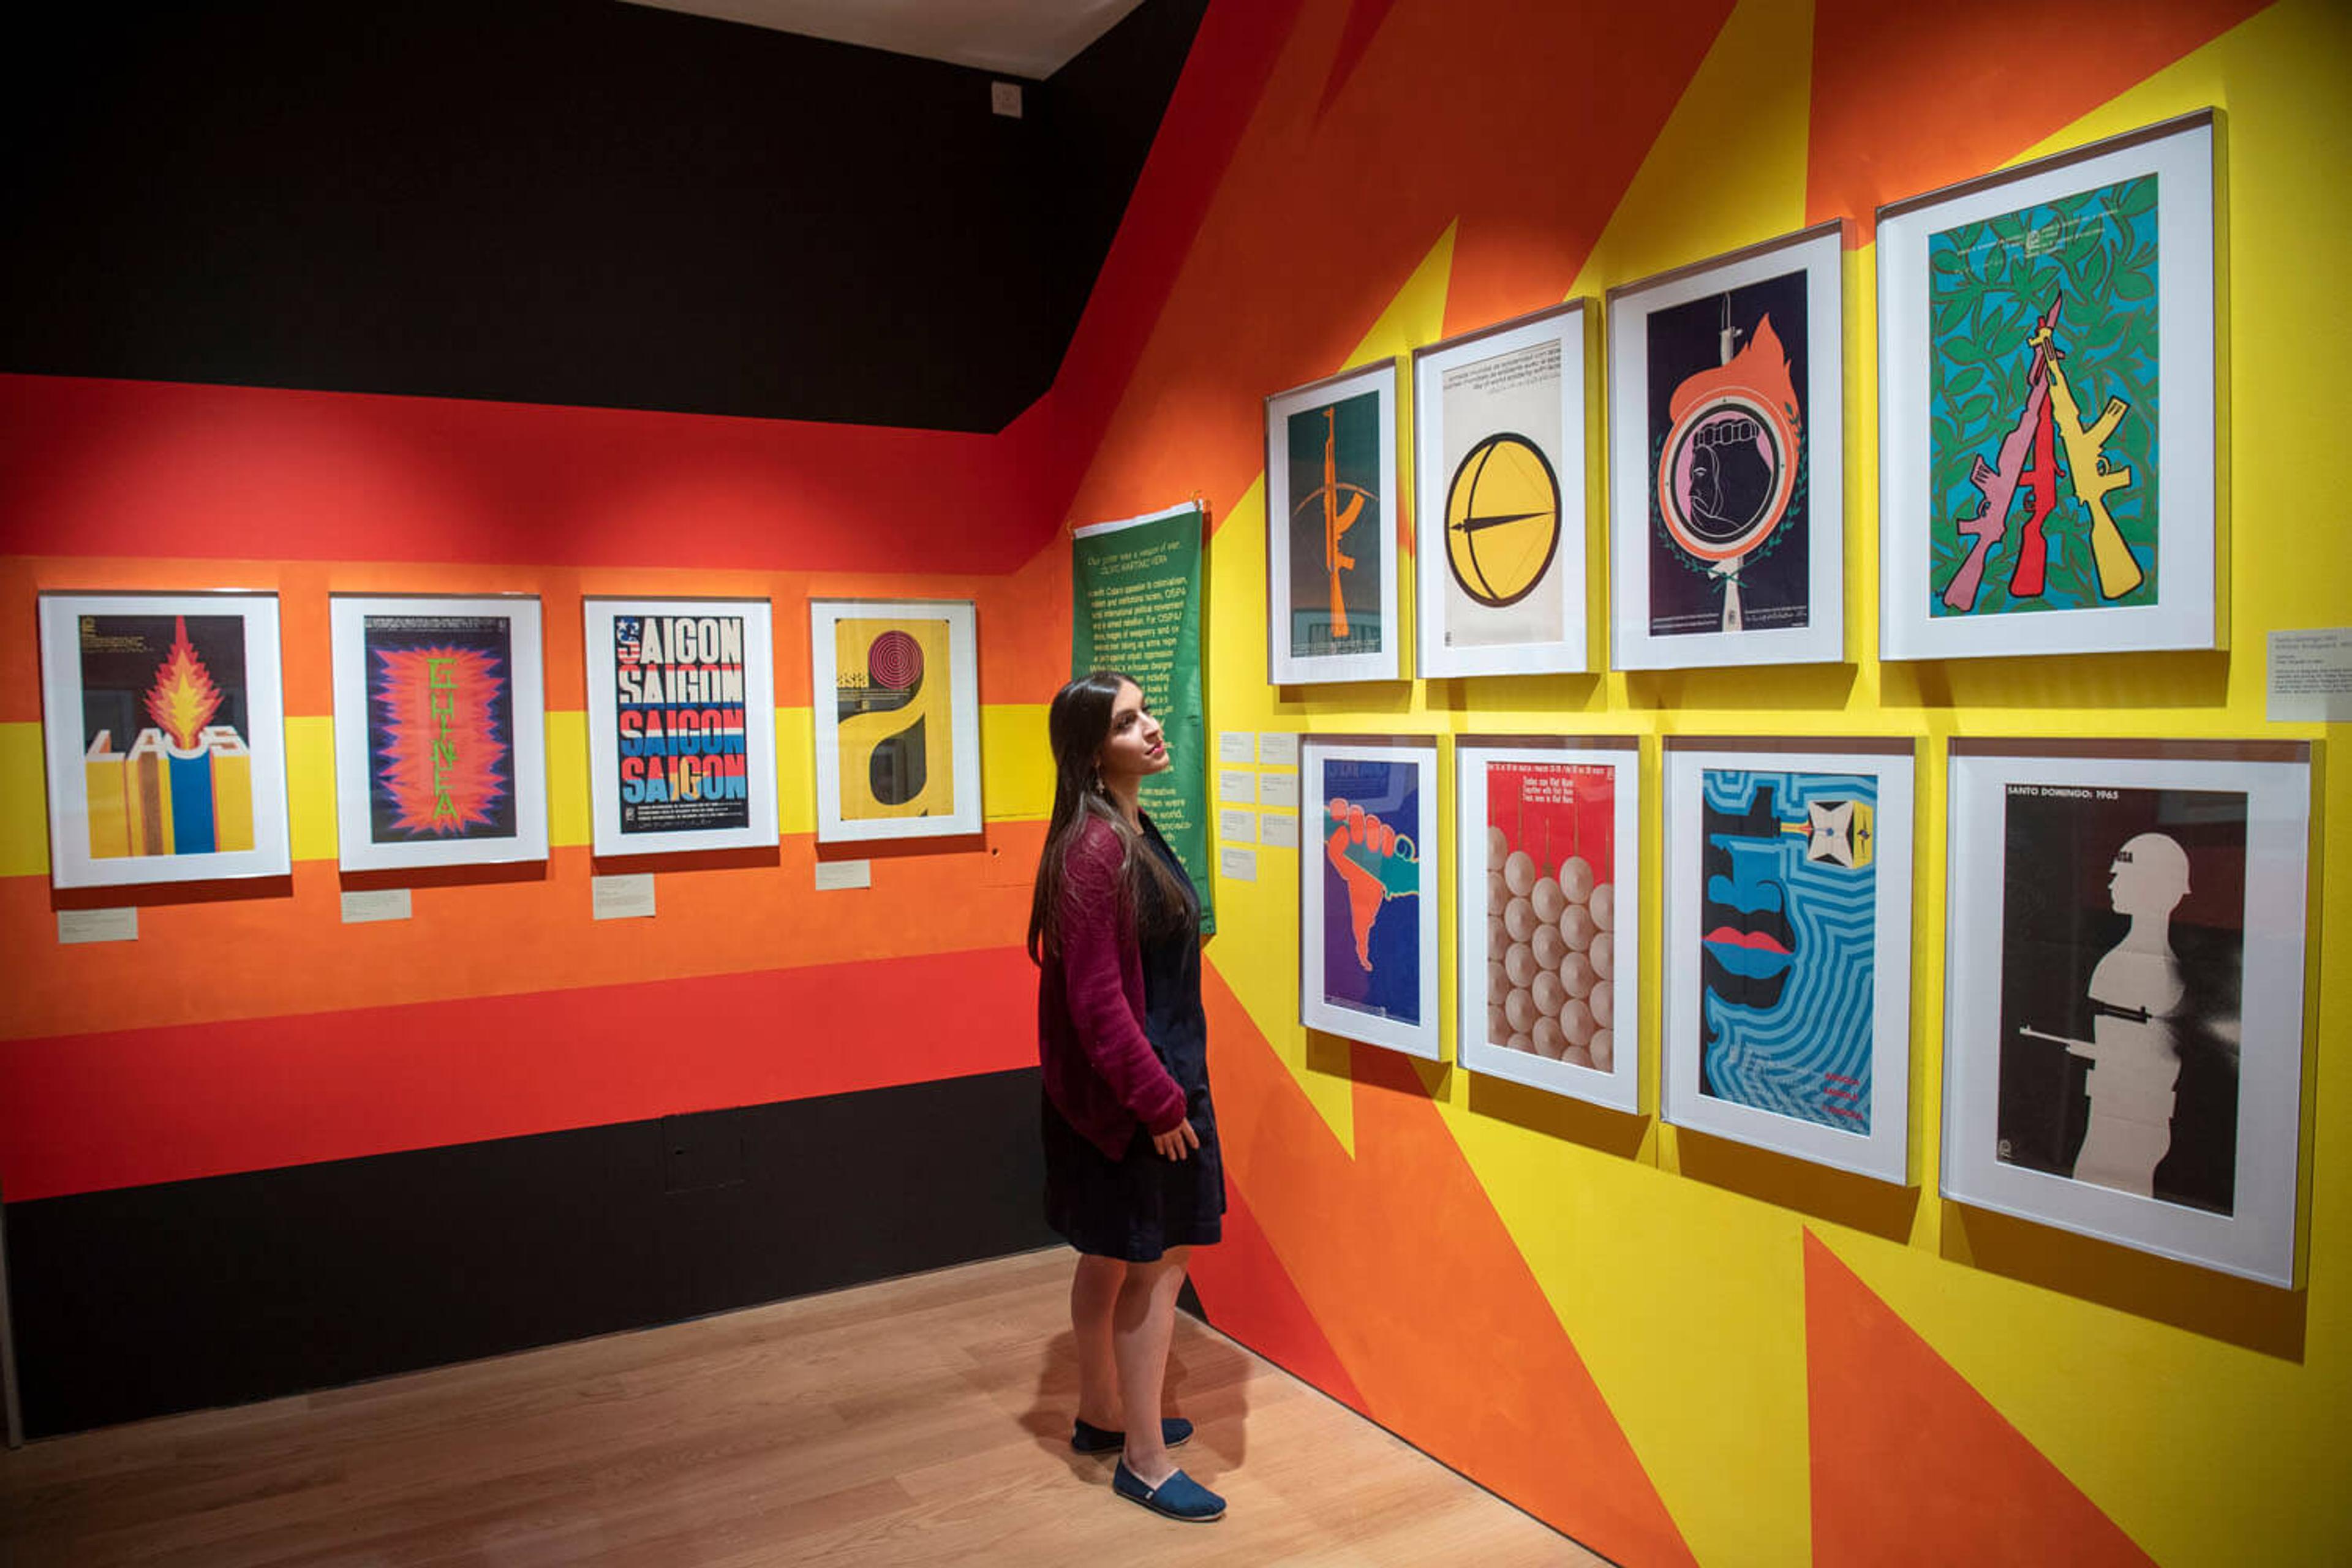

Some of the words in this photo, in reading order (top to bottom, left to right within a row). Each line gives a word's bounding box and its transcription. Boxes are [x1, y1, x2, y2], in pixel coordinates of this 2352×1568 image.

[616, 616, 742, 665] SAIGON
[619, 663, 743, 710] SAIGON
[620, 709, 745, 757] SAIGON
[622, 753, 747, 804] SAIGON
[2007, 786, 2039, 796] SANTO
[2041, 788, 2094, 799] DOMINGO:
[2095, 790, 2119, 800] 1965
